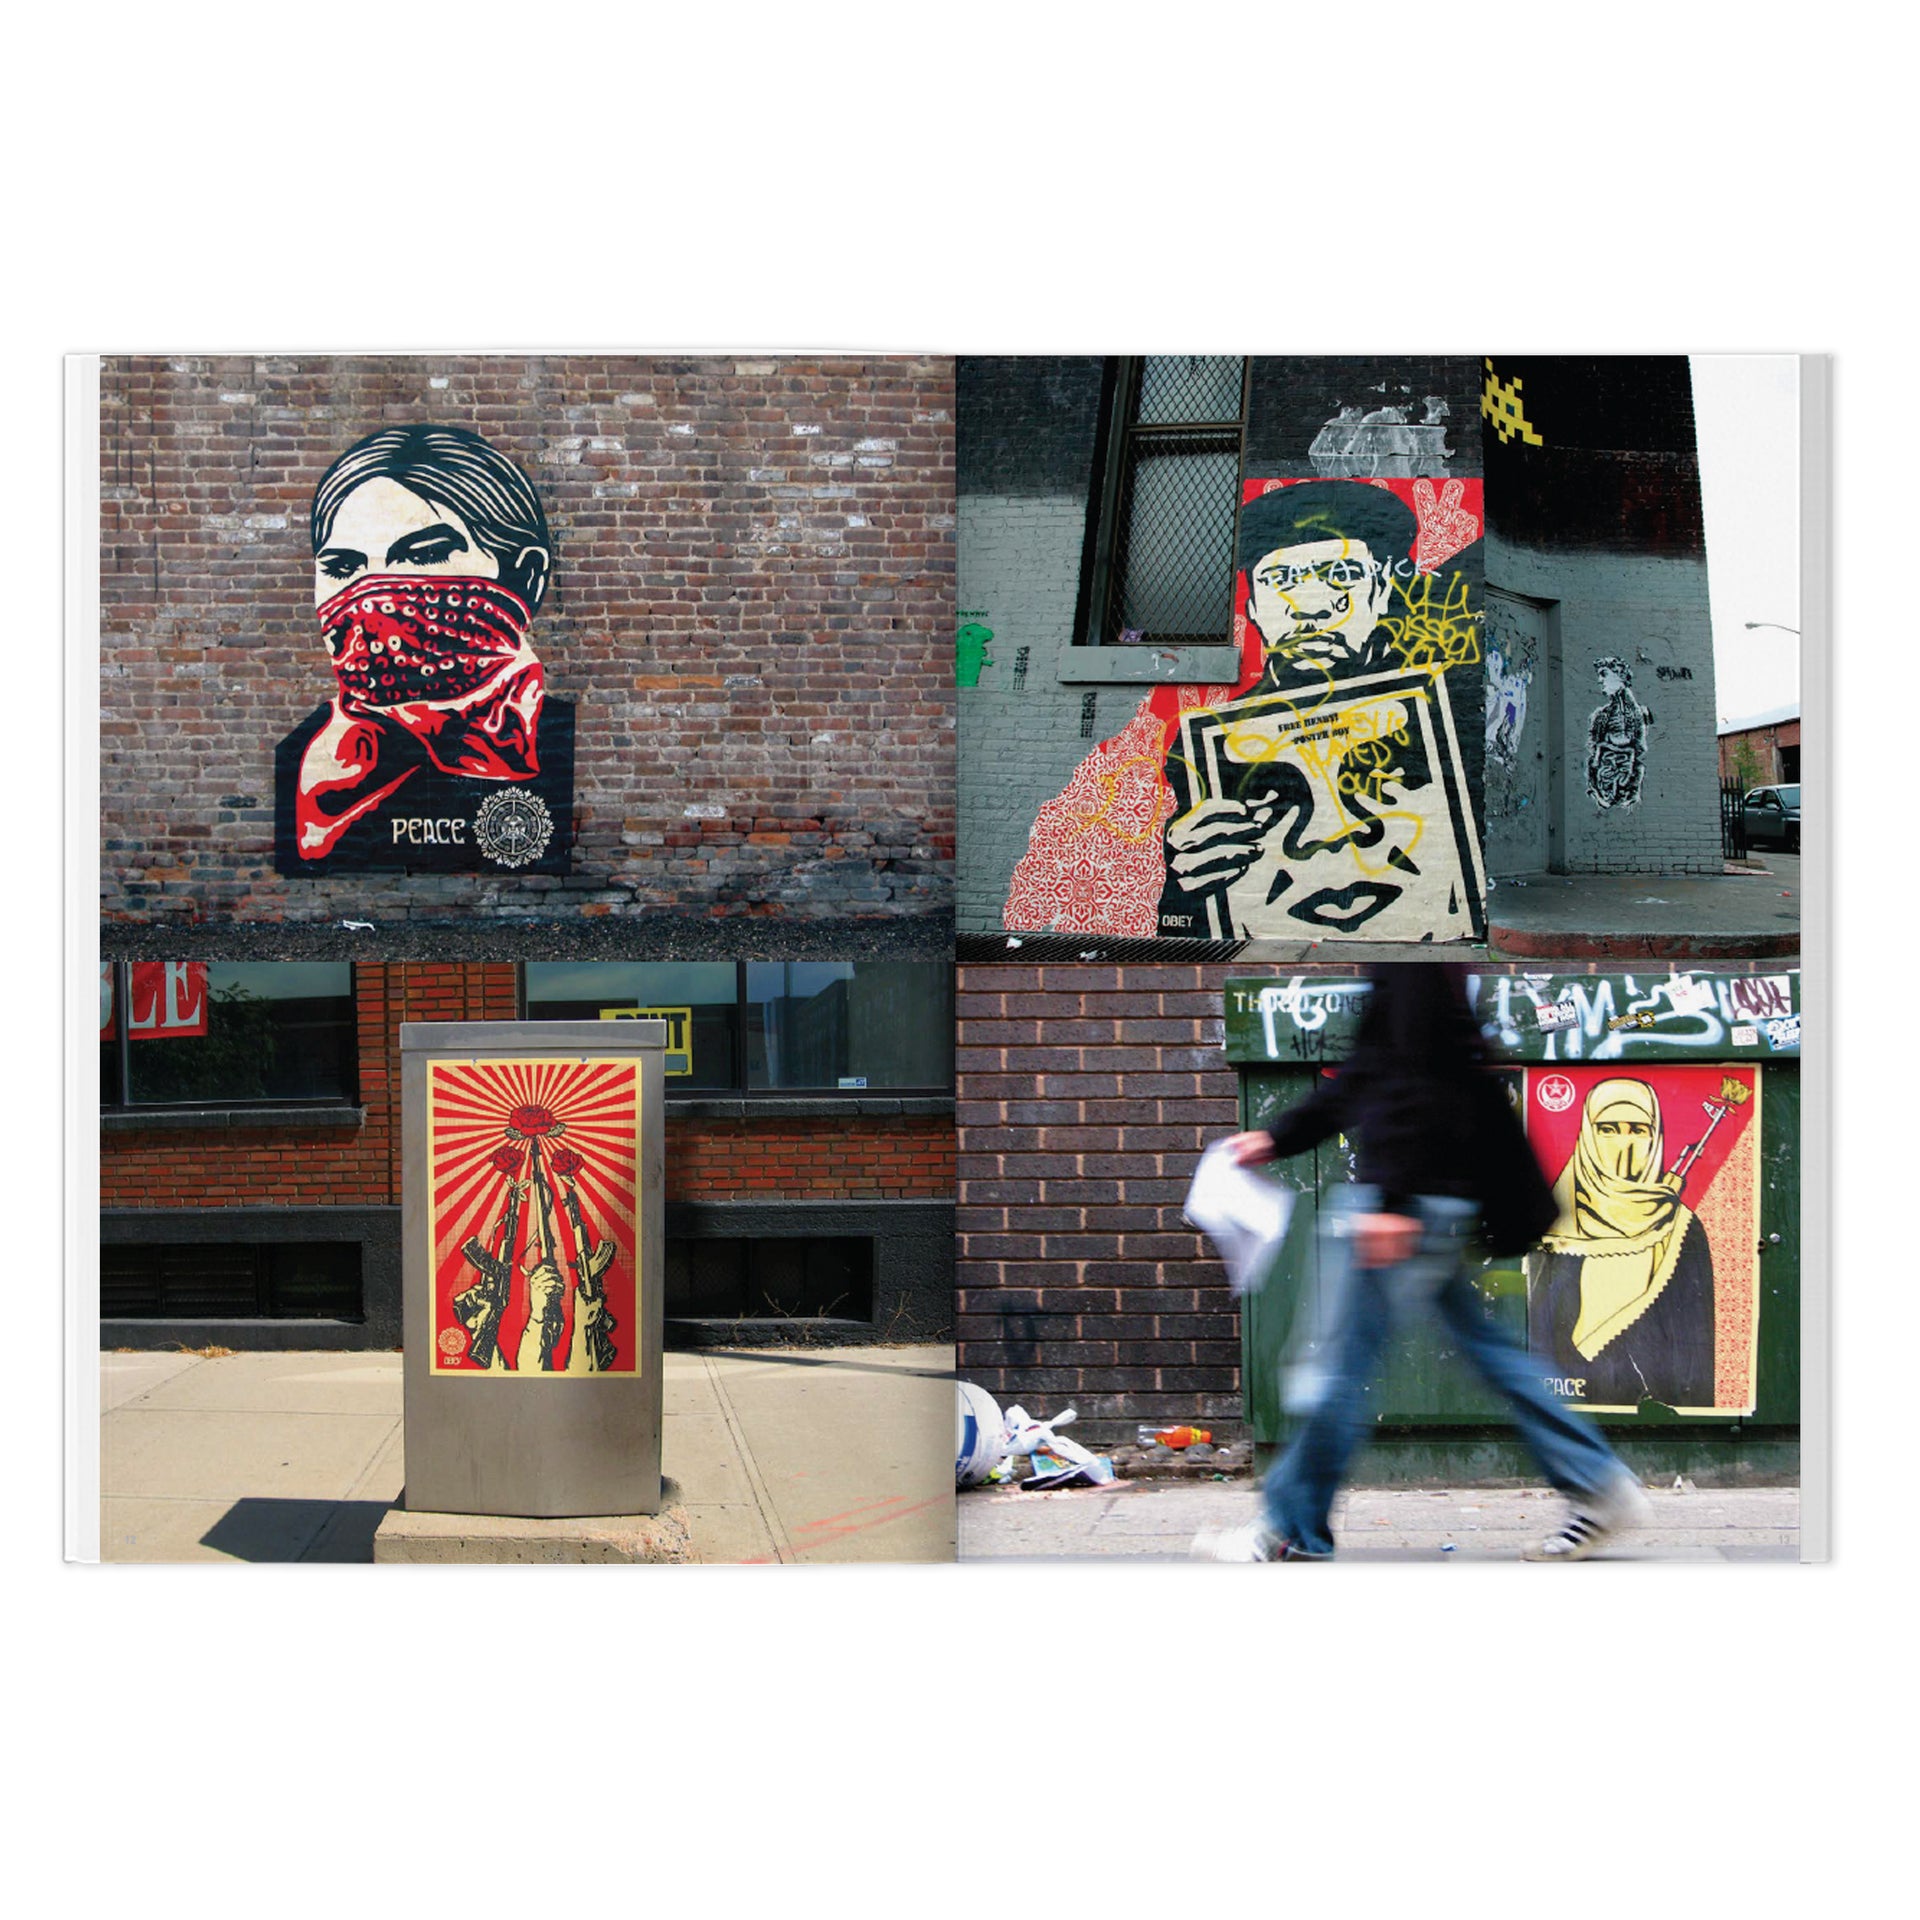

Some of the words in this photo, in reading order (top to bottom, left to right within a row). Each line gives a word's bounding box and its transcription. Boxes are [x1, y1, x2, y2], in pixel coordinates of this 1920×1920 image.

[1329, 559, 1352, 583] A
[1278, 720, 1301, 733] FREE
[1337, 770, 1403, 803] OUT
[391, 818, 466, 845] PEACE
[1162, 914, 1194, 927] OBEY
[100, 961, 202, 1030] LE
